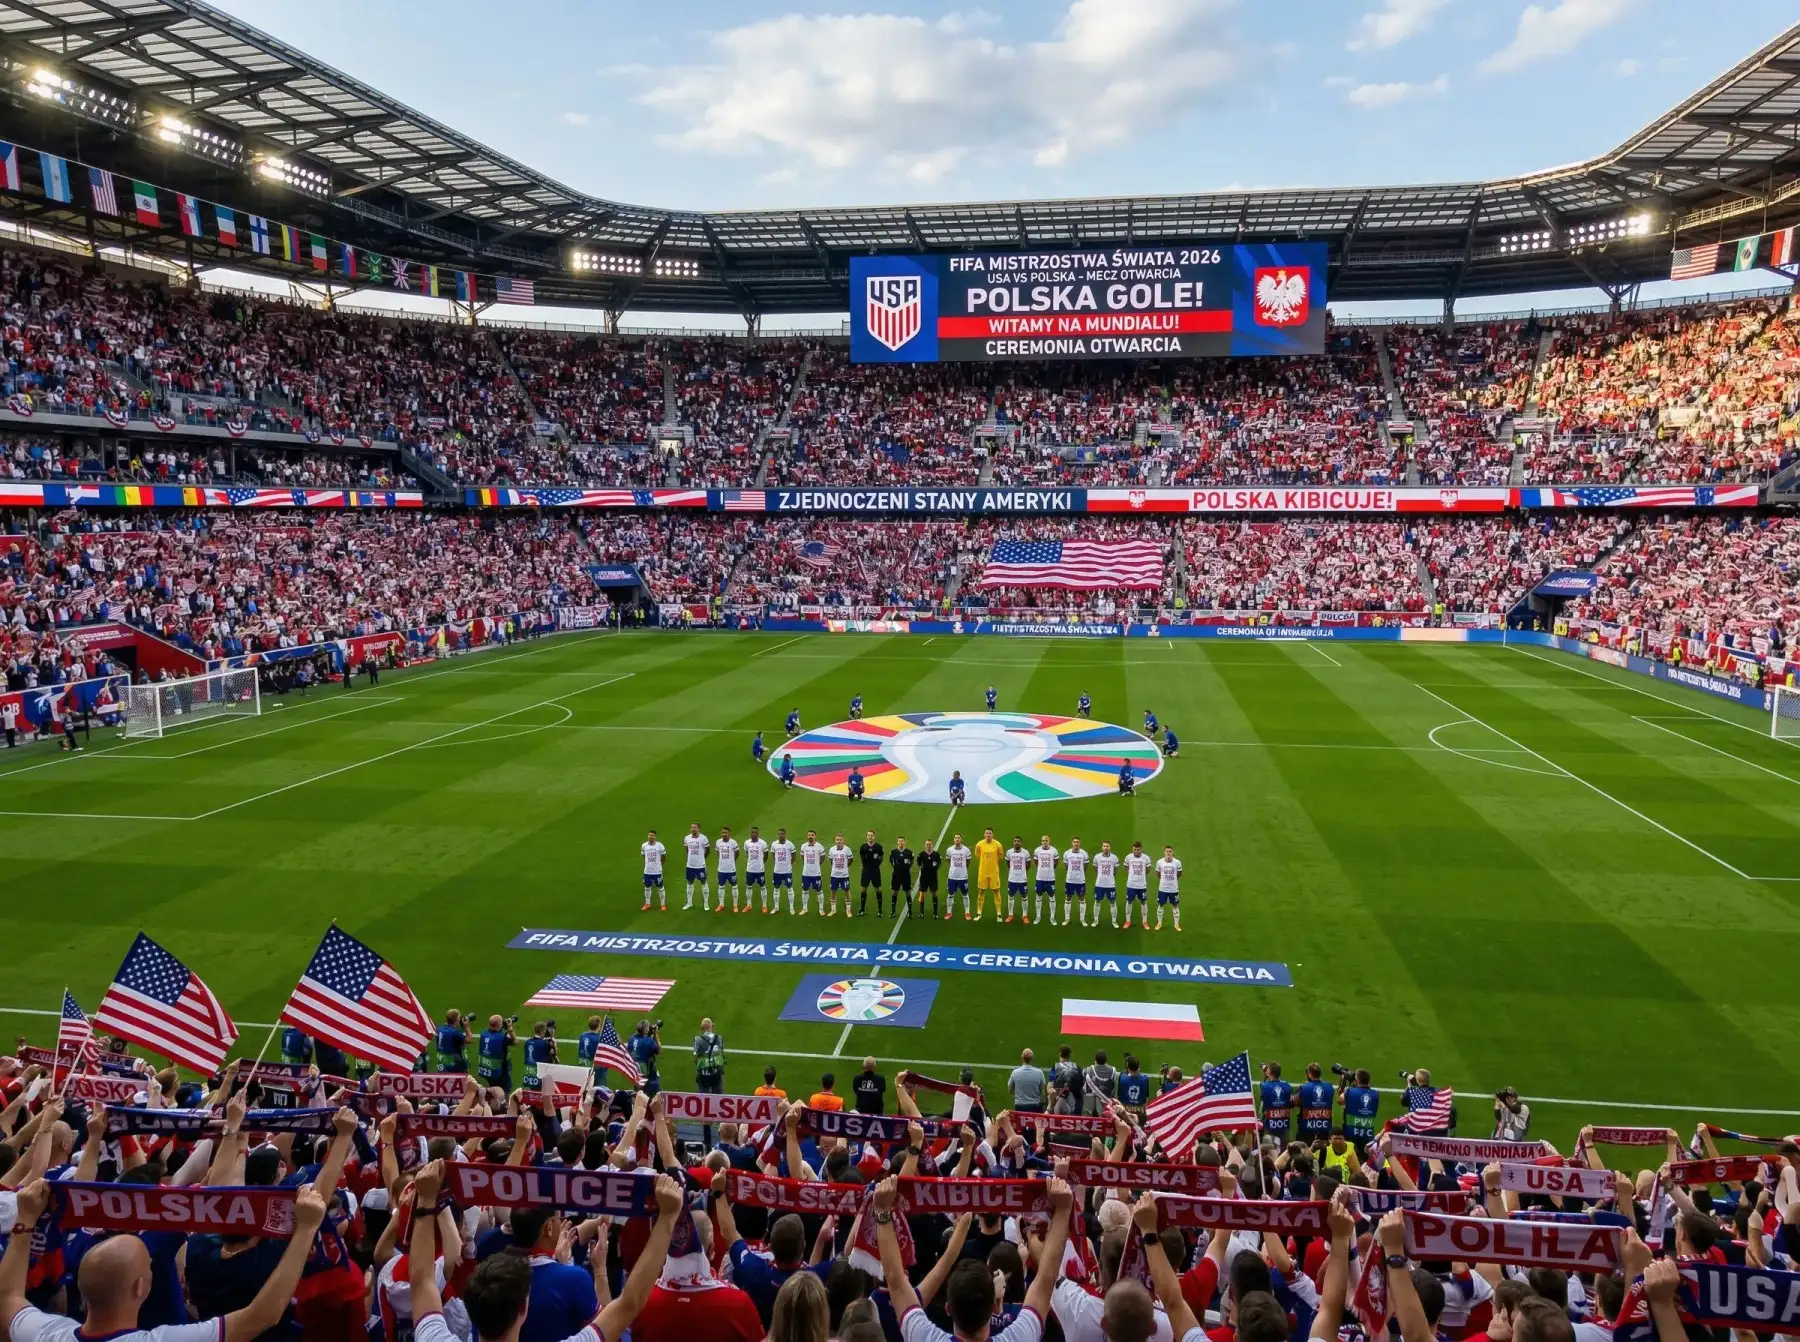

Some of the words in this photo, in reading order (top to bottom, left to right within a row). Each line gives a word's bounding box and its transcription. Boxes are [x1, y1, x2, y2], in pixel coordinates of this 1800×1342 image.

[950, 257, 985, 272] FIFA
[989, 254, 1108, 271] MISTRZOSTWA
[1112, 249, 1175, 267] ŚWIATA
[1180, 250, 1221, 265] 2026
[987, 273, 1011, 284] USA
[1013, 272, 1027, 283] VS
[1030, 271, 1076, 283] POLSKA
[1086, 270, 1117, 281] MECZ
[1120, 268, 1181, 280] OTWARCIA
[870, 280, 917, 308] USA
[967, 284, 1098, 312] POLSKA
[1106, 282, 1204, 310] GOLE!
[989, 317, 1055, 334] WITAMY
[1058, 317, 1082, 332] NA
[1086, 315, 1180, 332] MUNDIALU!
[986, 339, 1086, 355] CEREMONIA
[1090, 337, 1182, 354] OTWARCIA
[779, 492, 909, 509] ZJEDNOCZENI
[914, 492, 978, 510] STANY
[982, 492, 1071, 510] AMERYKI
[1193, 491, 1278, 509] POLSKA
[1285, 491, 1392, 509] KIBICUJE!
[1216, 627, 1265, 636] CEREMONIA
[525, 933, 579, 946] FIFA
[582, 937, 766, 956] MISTRZOSTWA
[772, 942, 869, 960] ŚWIATA
[876, 949, 940, 964] 2026
[963, 953, 1120, 973] CEREMONIA
[1128, 961, 1275, 981] OTWARCIA
[379, 1077, 464, 1094] POLSKA
[667, 1094, 772, 1120] POLSKA
[822, 1112, 886, 1139] USA
[1085, 1164, 1188, 1186] POLSKA
[1526, 1169, 1585, 1193] USA
[458, 1168, 635, 1209] POLICE
[737, 1175, 859, 1213] POLSKA
[914, 1182, 1024, 1207] KIBICE
[67, 1188, 256, 1225] POLSKA
[1166, 1201, 1321, 1229] POLSKA
